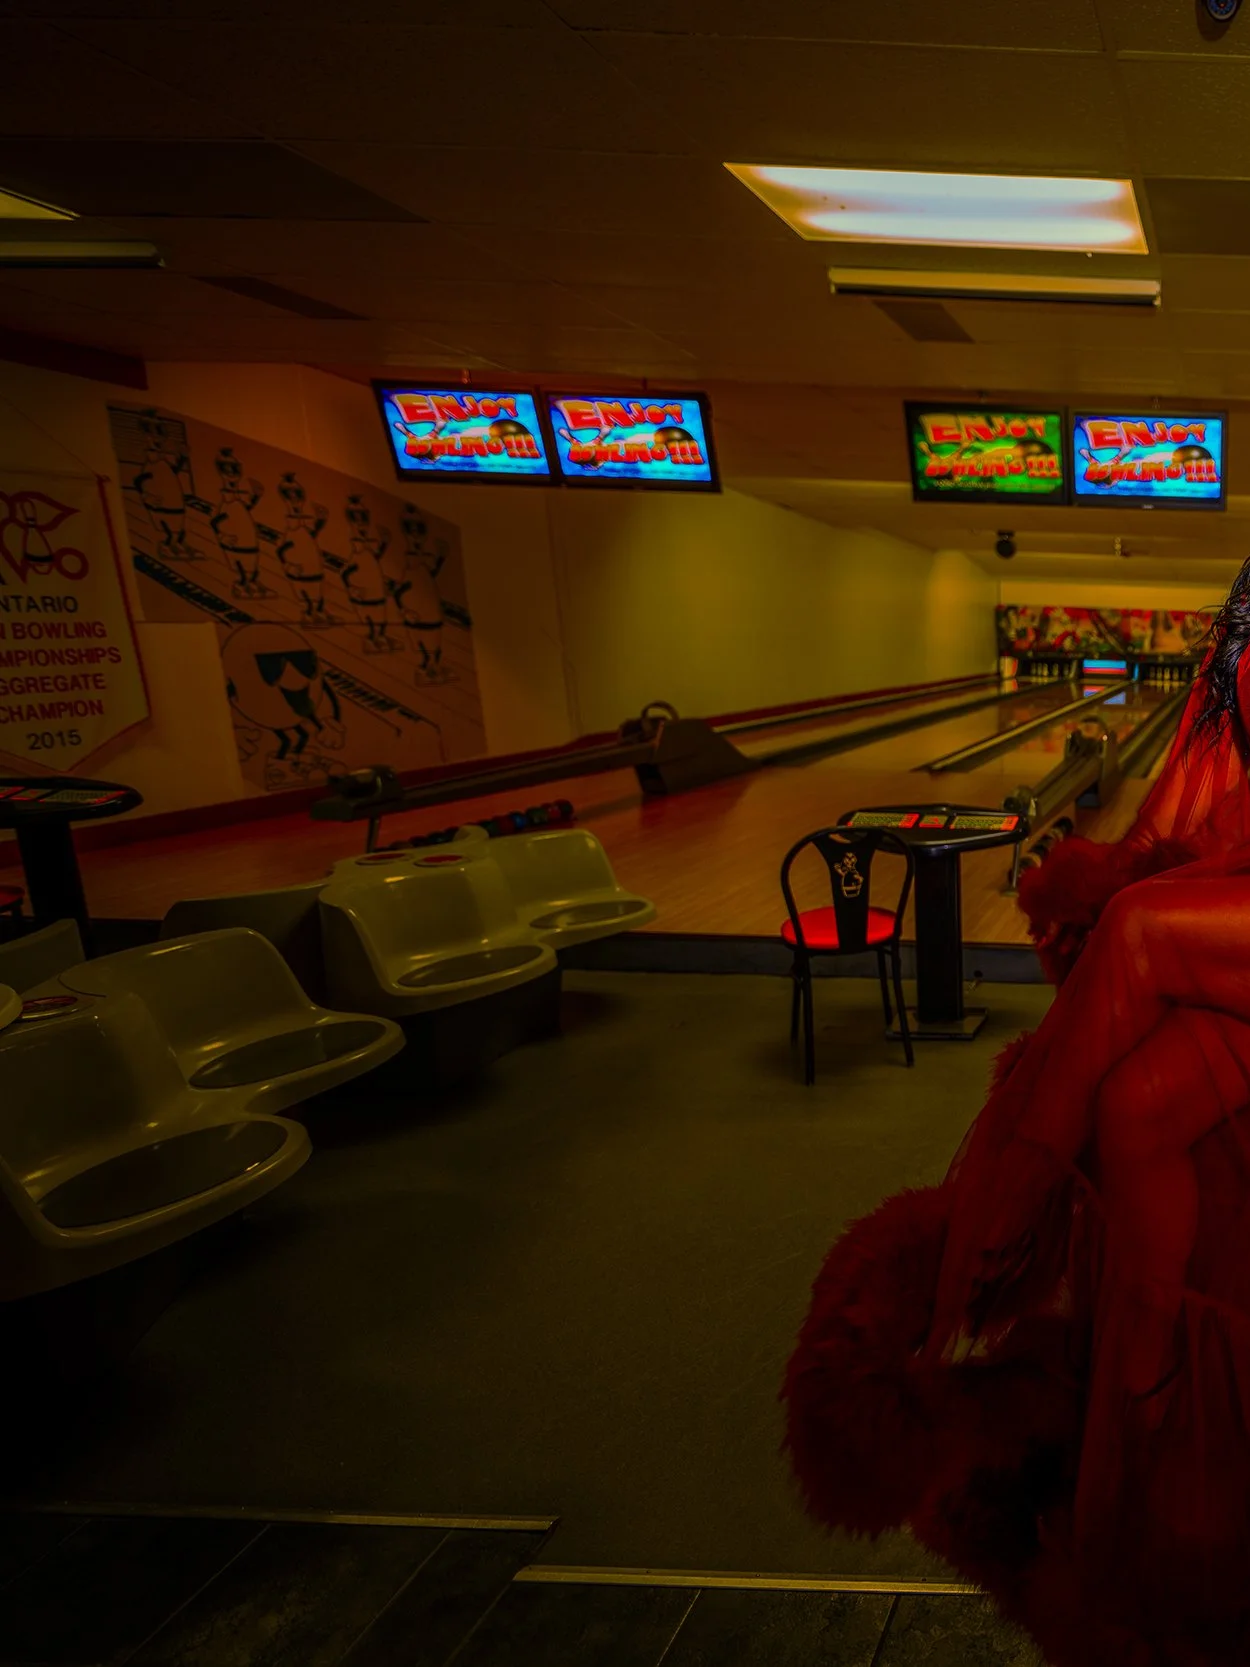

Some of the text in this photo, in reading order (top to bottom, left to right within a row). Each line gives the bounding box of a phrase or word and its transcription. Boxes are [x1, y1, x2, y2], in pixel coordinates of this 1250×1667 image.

[393, 392, 518, 424] ENJOY
[556, 400, 683, 429] ENJOY
[920, 413, 1045, 444] ENJOY
[1081, 420, 1205, 449] ENJOY
[12, 621, 107, 640] BOWLING
[27, 729, 82, 750] 2015
